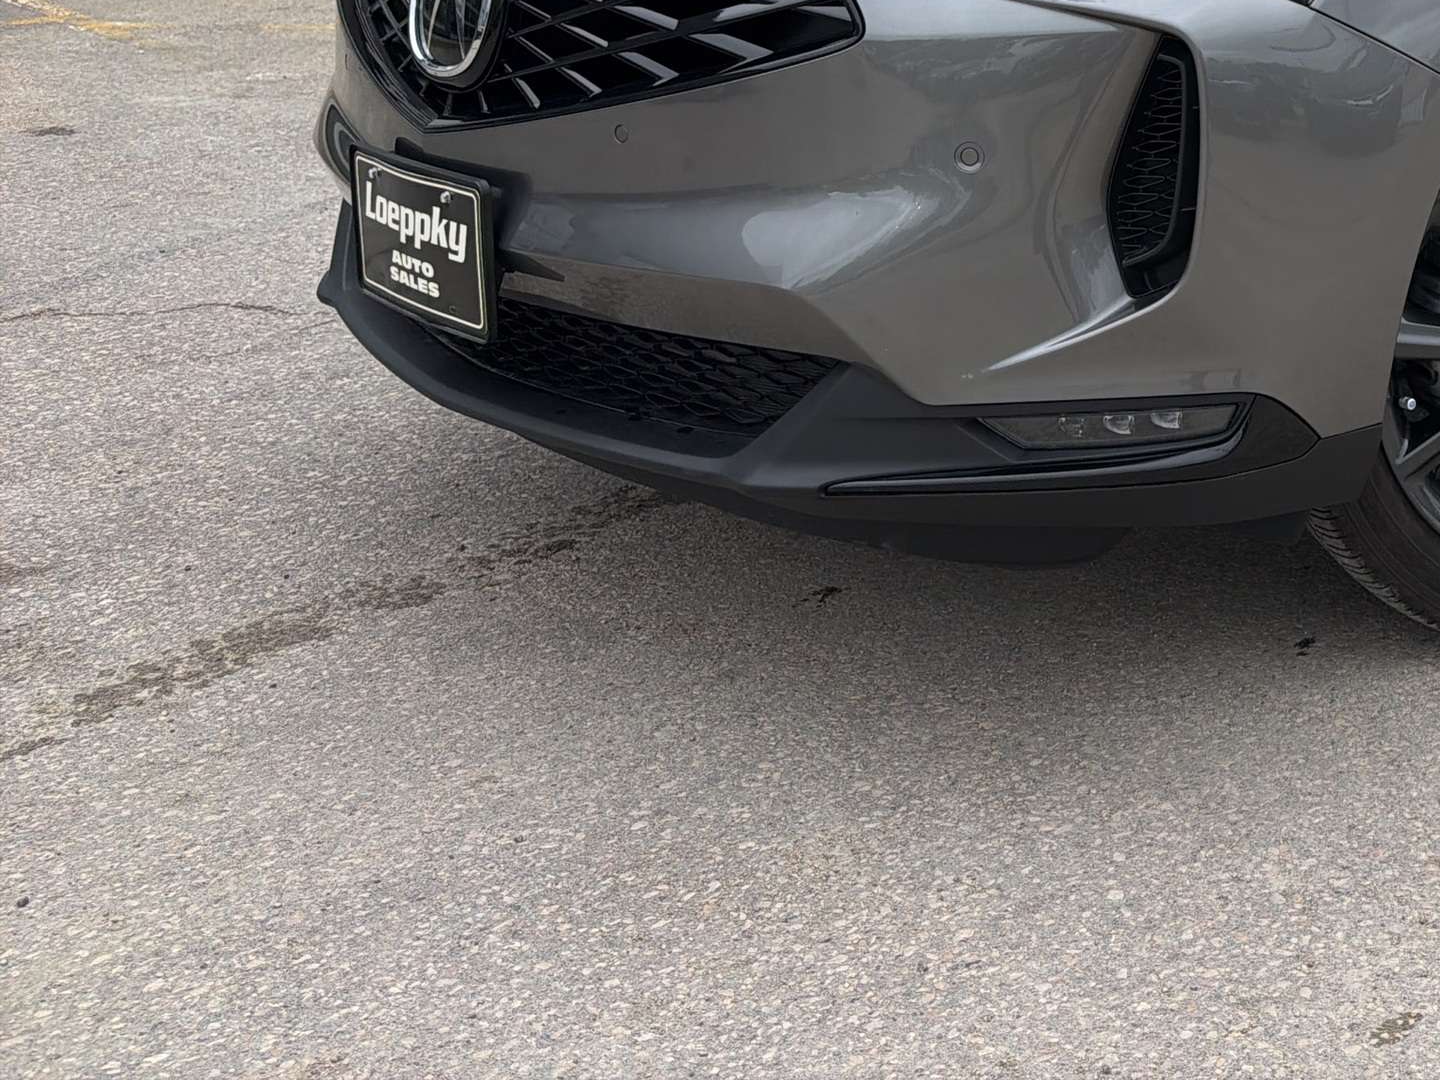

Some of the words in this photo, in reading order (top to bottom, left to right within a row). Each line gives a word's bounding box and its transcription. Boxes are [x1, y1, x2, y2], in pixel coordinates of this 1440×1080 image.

[366, 180, 468, 264] Loeppky
[392, 249, 435, 279] AUTO
[389, 265, 440, 299] SALES
